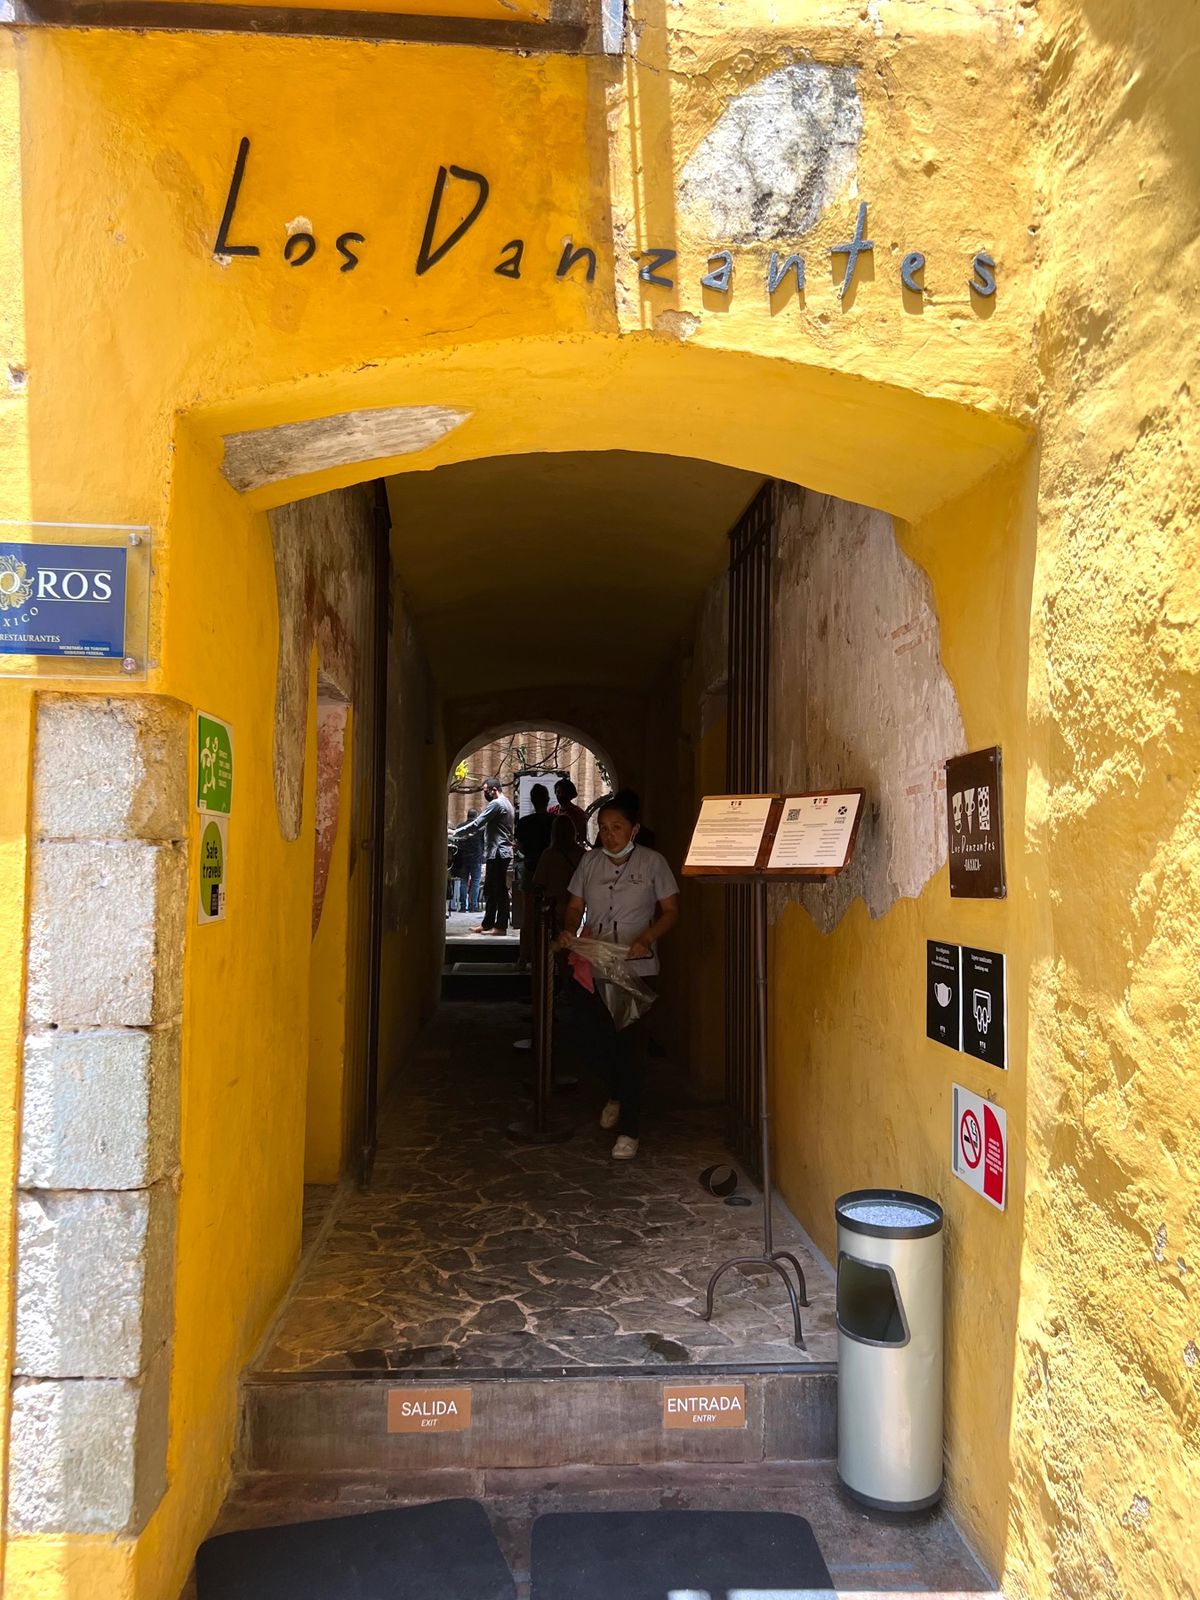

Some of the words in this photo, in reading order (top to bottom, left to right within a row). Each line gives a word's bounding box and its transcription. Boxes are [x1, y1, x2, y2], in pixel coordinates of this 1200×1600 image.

[212, 136, 365, 273] Los
[416, 164, 997, 298] Danzantes
[205, 840, 218, 860] Safe
[961, 833, 996, 854] Danzantes
[202, 859, 222, 879] travels
[401, 1400, 458, 1417] SALIDA
[666, 1396, 742, 1413] ENTRADA
[421, 1418, 438, 1427] EXIT
[692, 1414, 717, 1423] ENTRY
